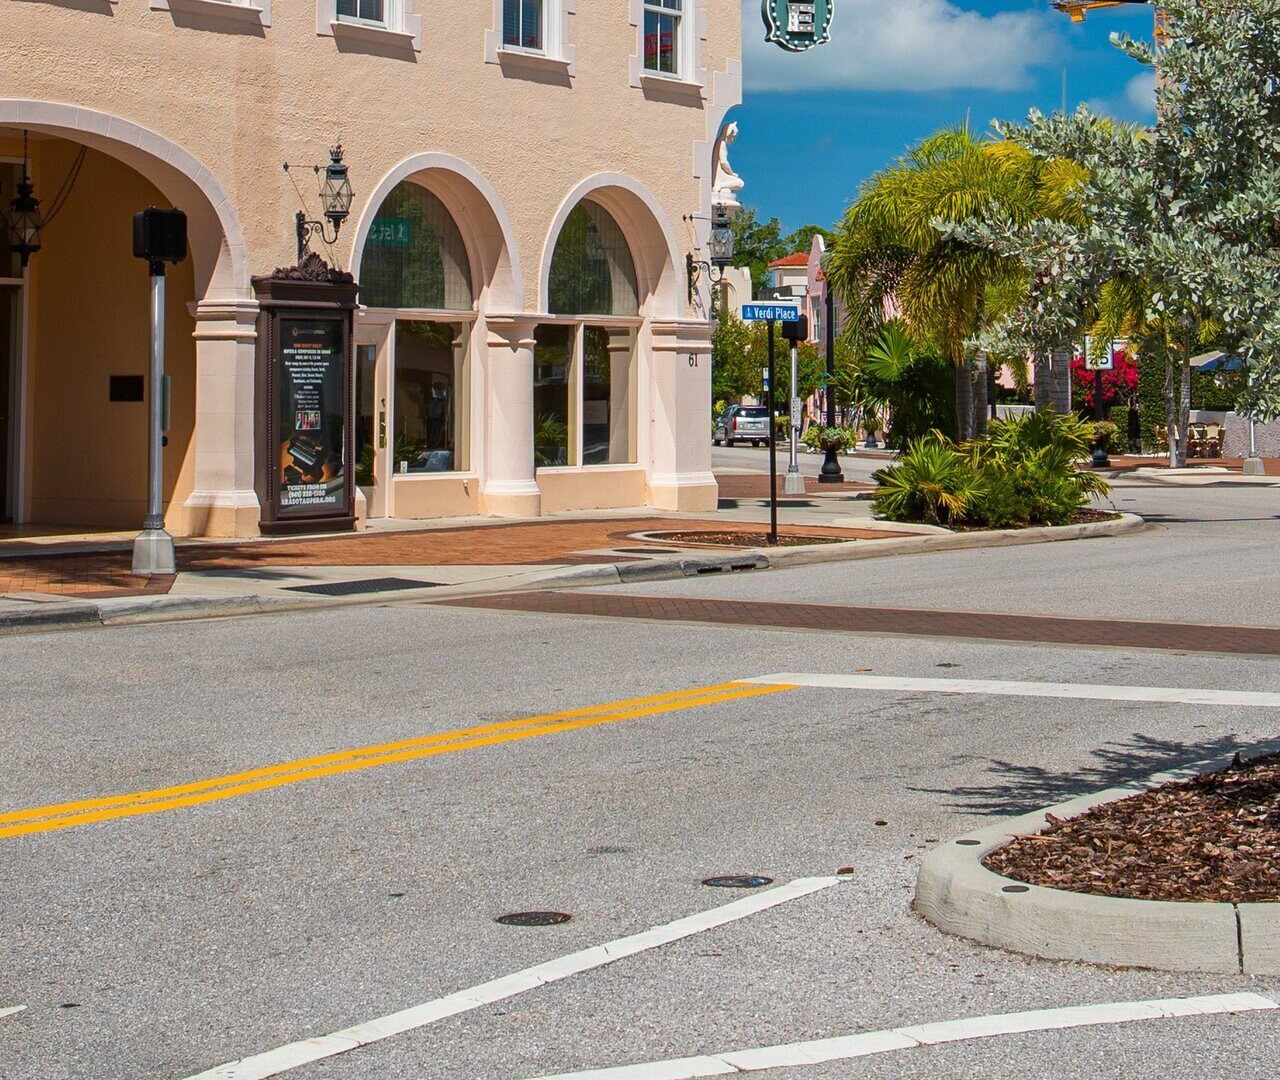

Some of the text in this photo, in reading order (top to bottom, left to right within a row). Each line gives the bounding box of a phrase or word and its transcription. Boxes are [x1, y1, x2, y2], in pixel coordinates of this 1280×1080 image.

[753, 306, 795, 320] Verdi Place
[688, 352, 698, 367] 61
